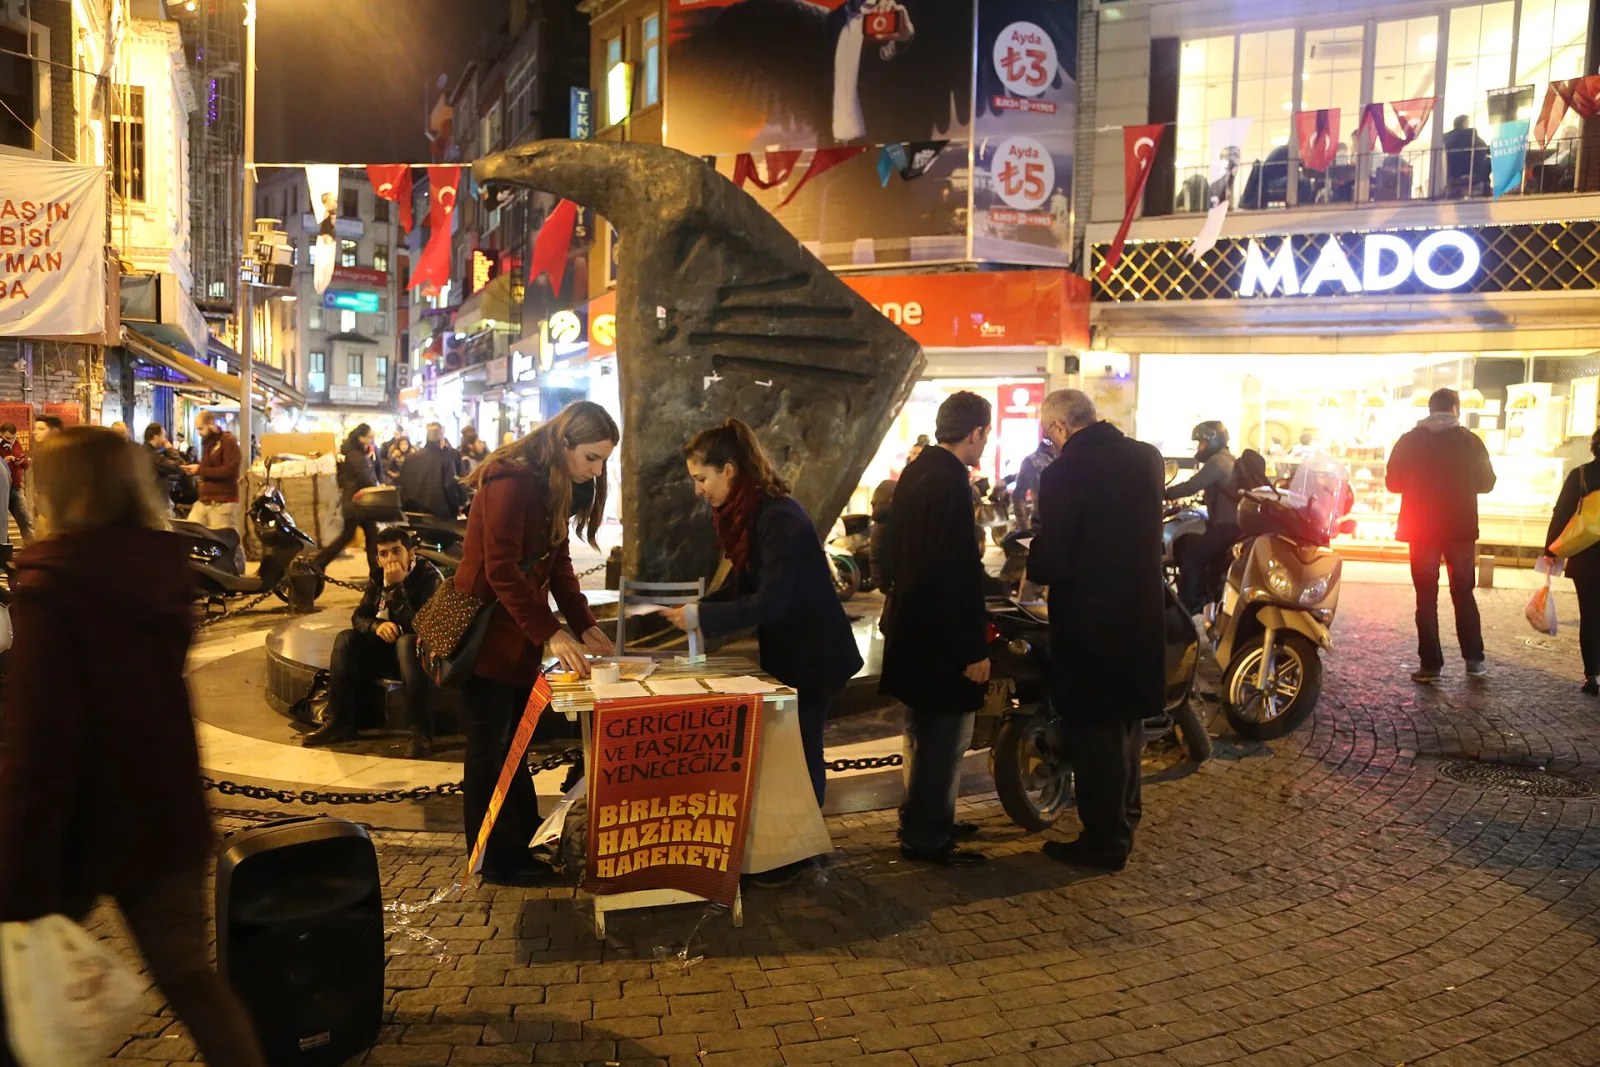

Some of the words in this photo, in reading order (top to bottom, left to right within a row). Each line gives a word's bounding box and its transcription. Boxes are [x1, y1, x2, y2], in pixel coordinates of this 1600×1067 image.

[1011, 30, 1042, 45] Ayda
[1008, 145, 1039, 160] Ayda
[0, 252, 62, 273] MAN
[1240, 230, 1480, 297] MADO
[871, 301, 923, 326] ne
[604, 746, 627, 762] VE
[635, 729, 730, 759] FAŞİZMİ
[599, 789, 738, 828] BİRLEŞİK
[598, 817, 735, 856] HAZİRAN
[596, 846, 729, 878] HAREKETİ
